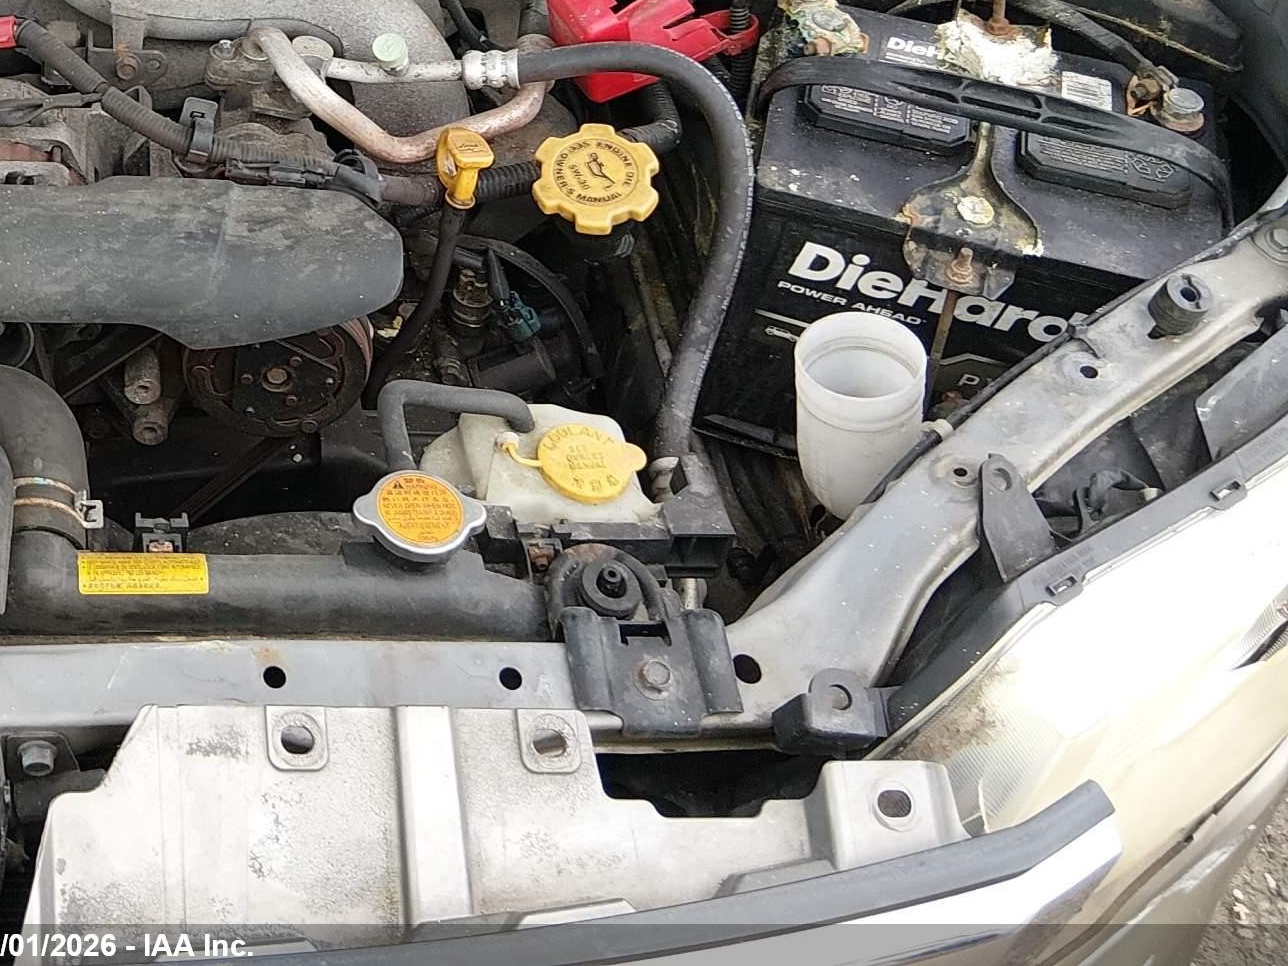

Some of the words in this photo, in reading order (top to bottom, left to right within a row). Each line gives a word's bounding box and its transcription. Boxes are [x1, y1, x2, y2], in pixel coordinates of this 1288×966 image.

[596, 141, 633, 167] ENGINE
[622, 171, 635, 186] OIL
[575, 191, 623, 203] MANUAL
[777, 280, 847, 307] POWER
[788, 240, 1089, 343] DieHard
[542, 425, 616, 451] COOLANT
